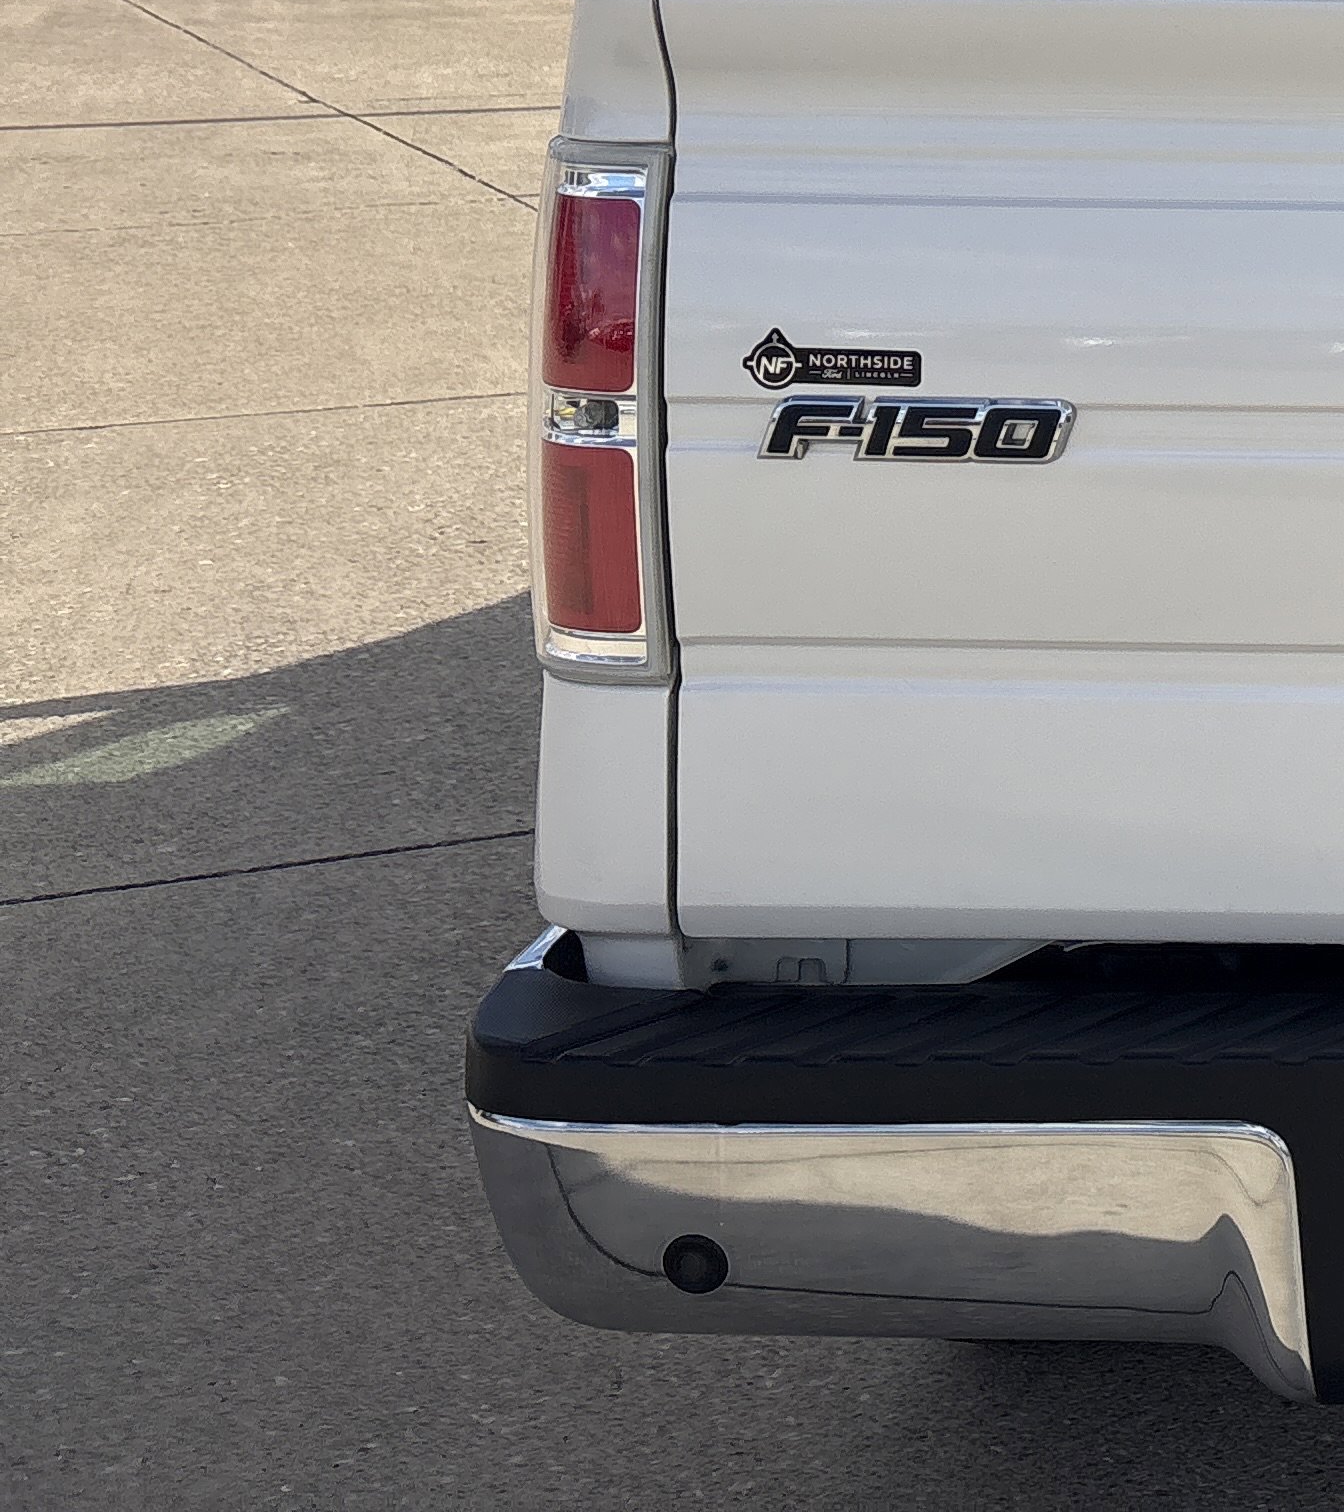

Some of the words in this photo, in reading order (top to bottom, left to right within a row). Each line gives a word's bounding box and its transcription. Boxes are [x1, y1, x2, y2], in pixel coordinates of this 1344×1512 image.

[758, 356, 793, 380] NF
[808, 353, 914, 370] NORTHSIDE
[821, 369, 843, 379] Ford
[855, 371, 899, 379] LINCOLN
[757, 395, 1077, 464] F-150
